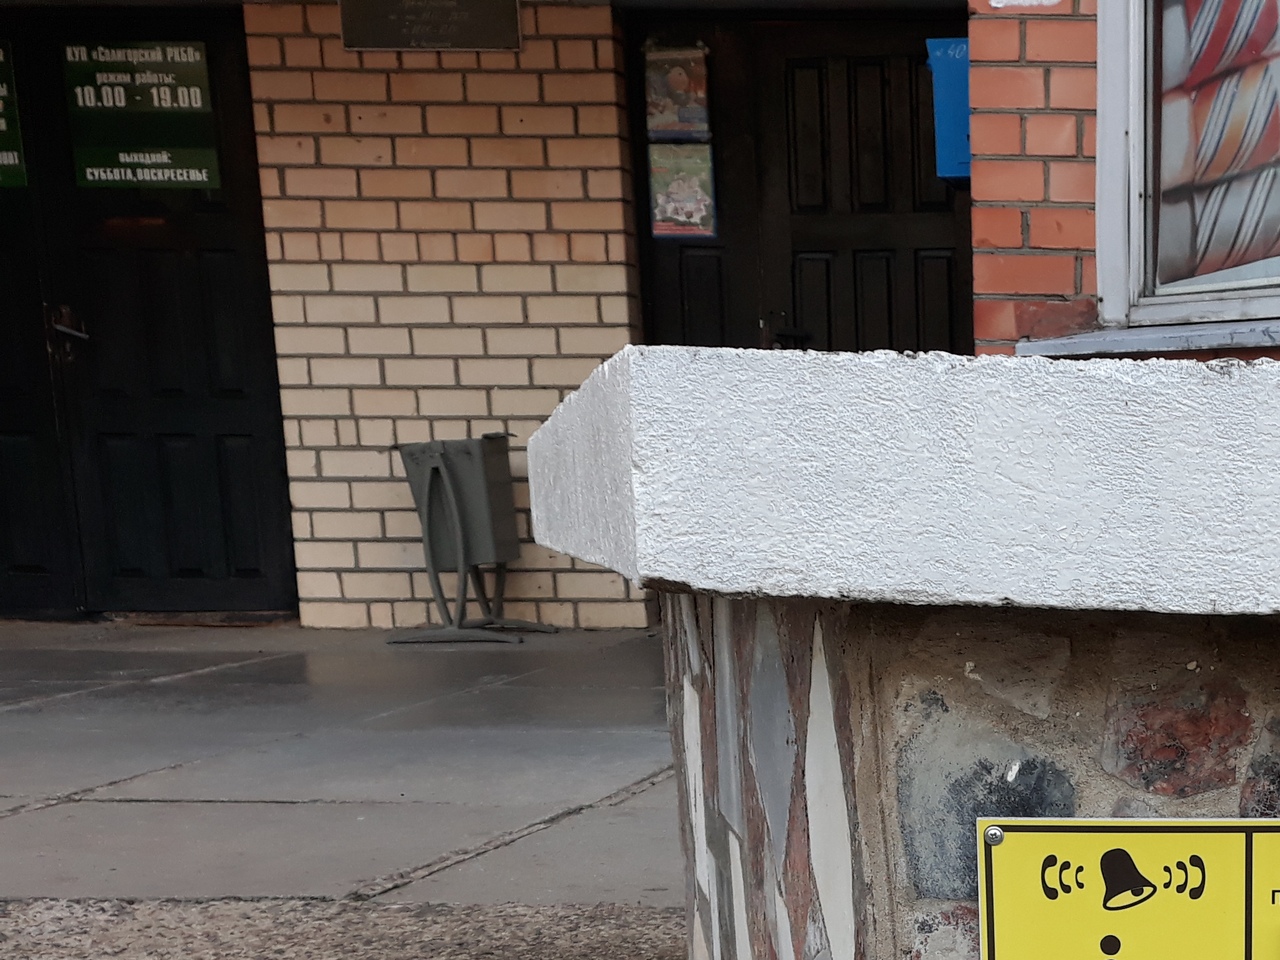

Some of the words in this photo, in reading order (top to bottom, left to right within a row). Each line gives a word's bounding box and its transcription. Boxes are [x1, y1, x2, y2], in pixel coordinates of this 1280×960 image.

[66, 46, 87, 62] КУП
[74, 86, 127, 108] 10.00
[150, 86, 202, 109] 19.00
